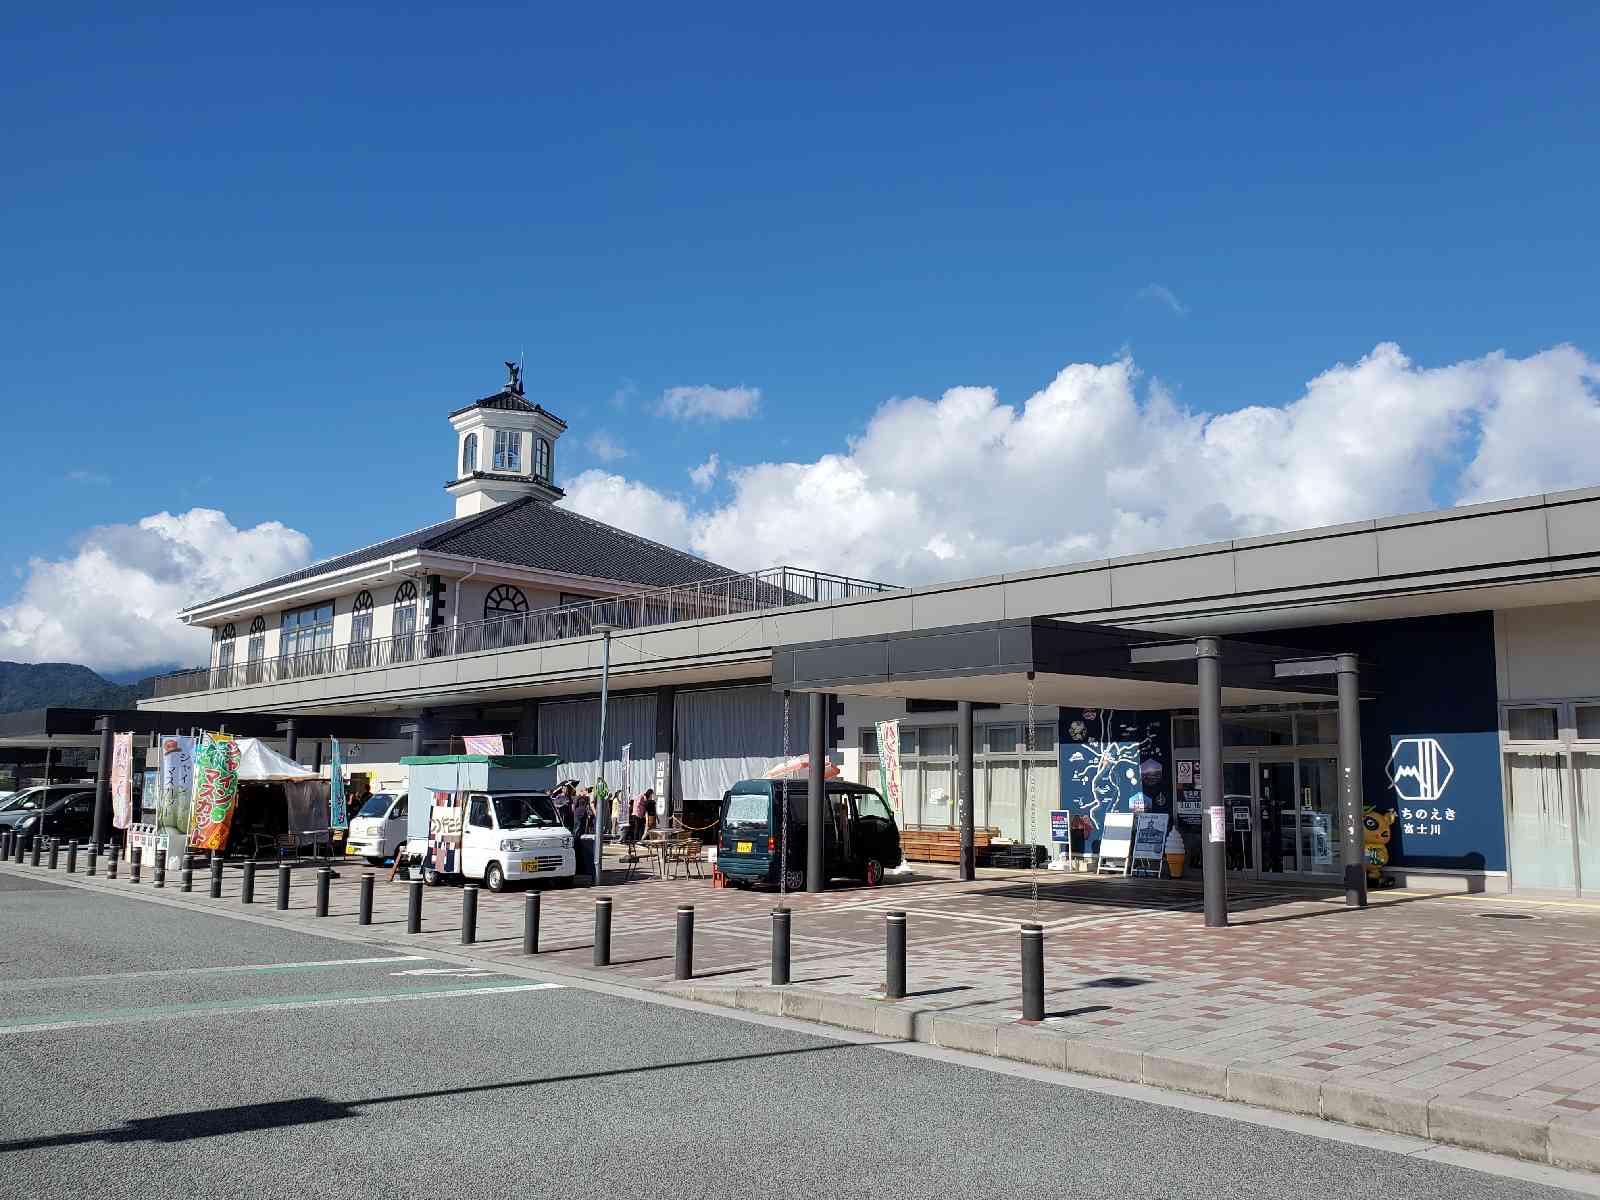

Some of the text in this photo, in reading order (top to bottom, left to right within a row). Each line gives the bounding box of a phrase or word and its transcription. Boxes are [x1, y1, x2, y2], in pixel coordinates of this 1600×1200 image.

[179, 753, 191, 795] シャイン
[215, 741, 241, 806] シャイン
[191, 768, 218, 845] マスカット
[1395, 807, 1457, 821] ちのえき
[1403, 823, 1441, 836] 富士川
